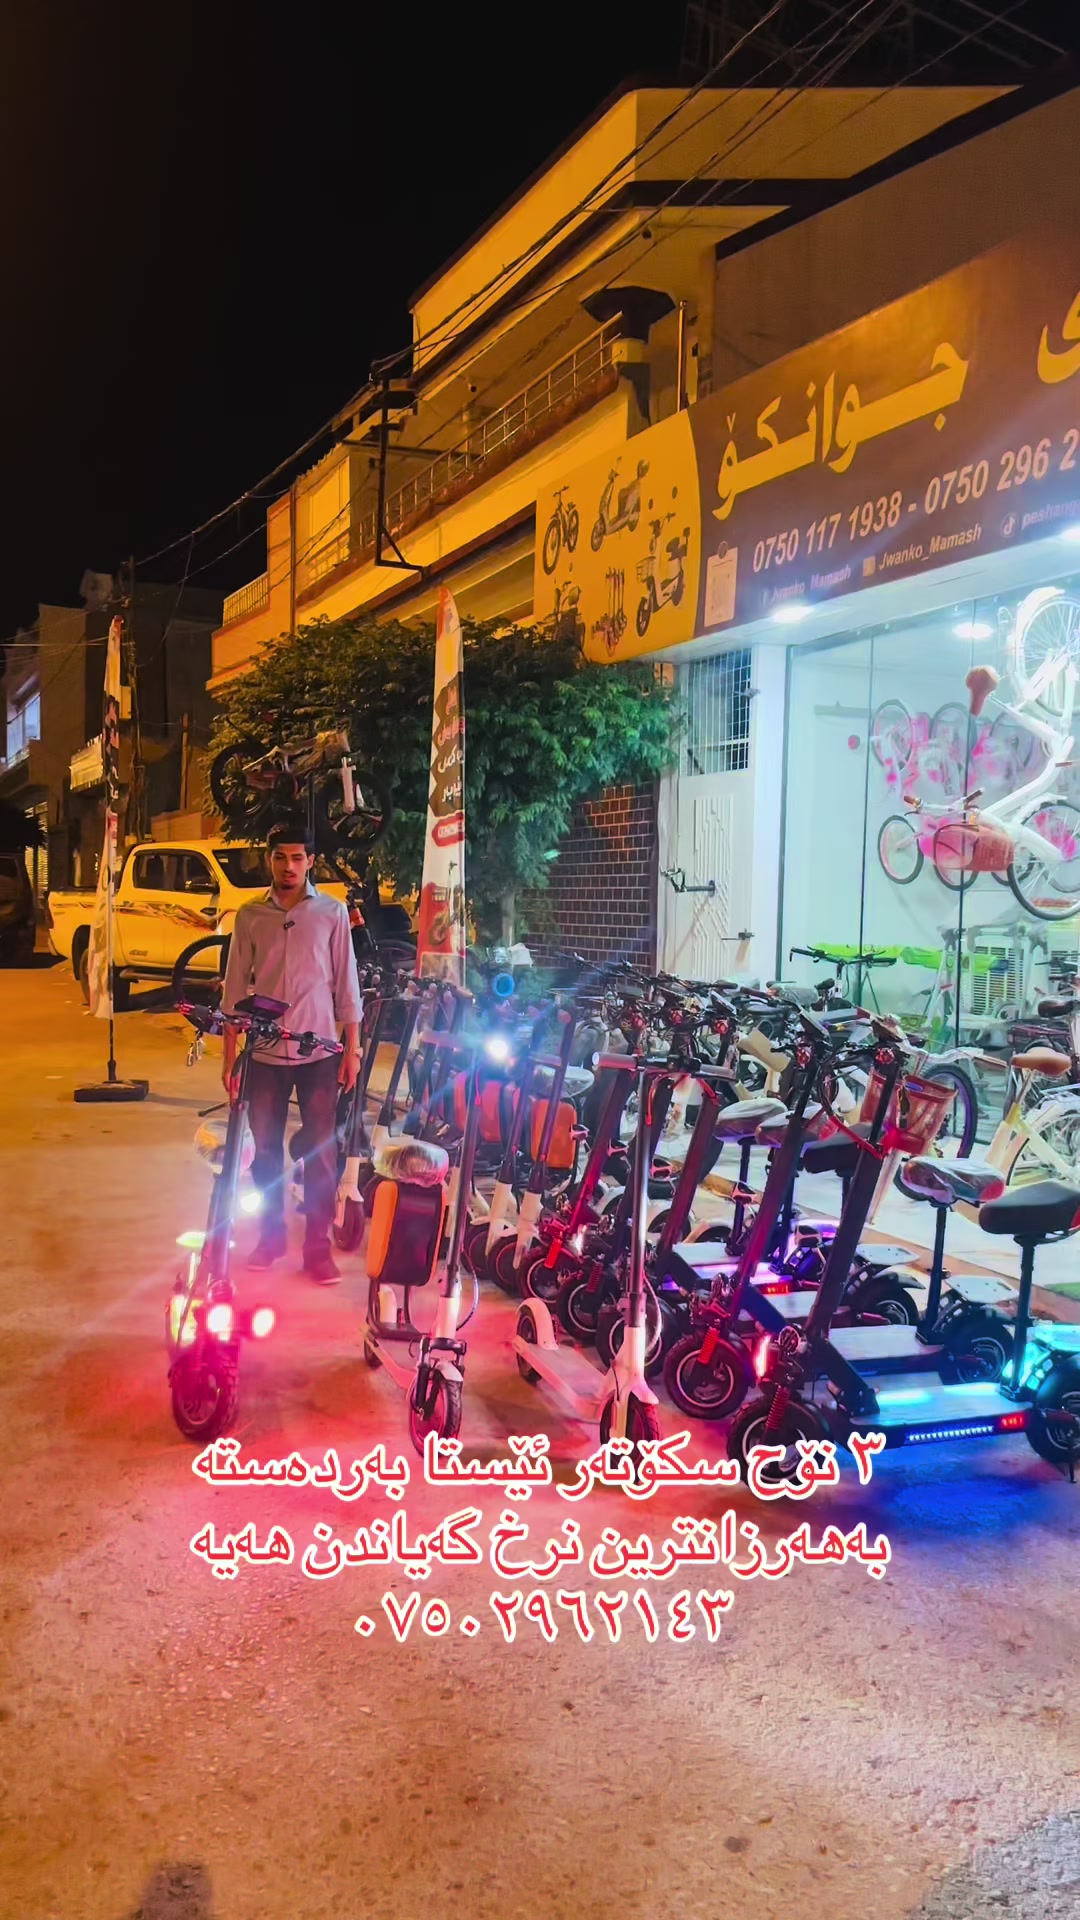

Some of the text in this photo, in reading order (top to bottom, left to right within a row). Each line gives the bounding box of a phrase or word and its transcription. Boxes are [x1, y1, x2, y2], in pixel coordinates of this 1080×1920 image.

[753, 528, 799, 572] 0750
[806, 512, 842, 555] 117
[848, 490, 903, 541] 1938
[924, 459, 990, 515] 0750
[996, 438, 1052, 492] 296
[878, 523, 982, 570] Jwanko_Mamash
